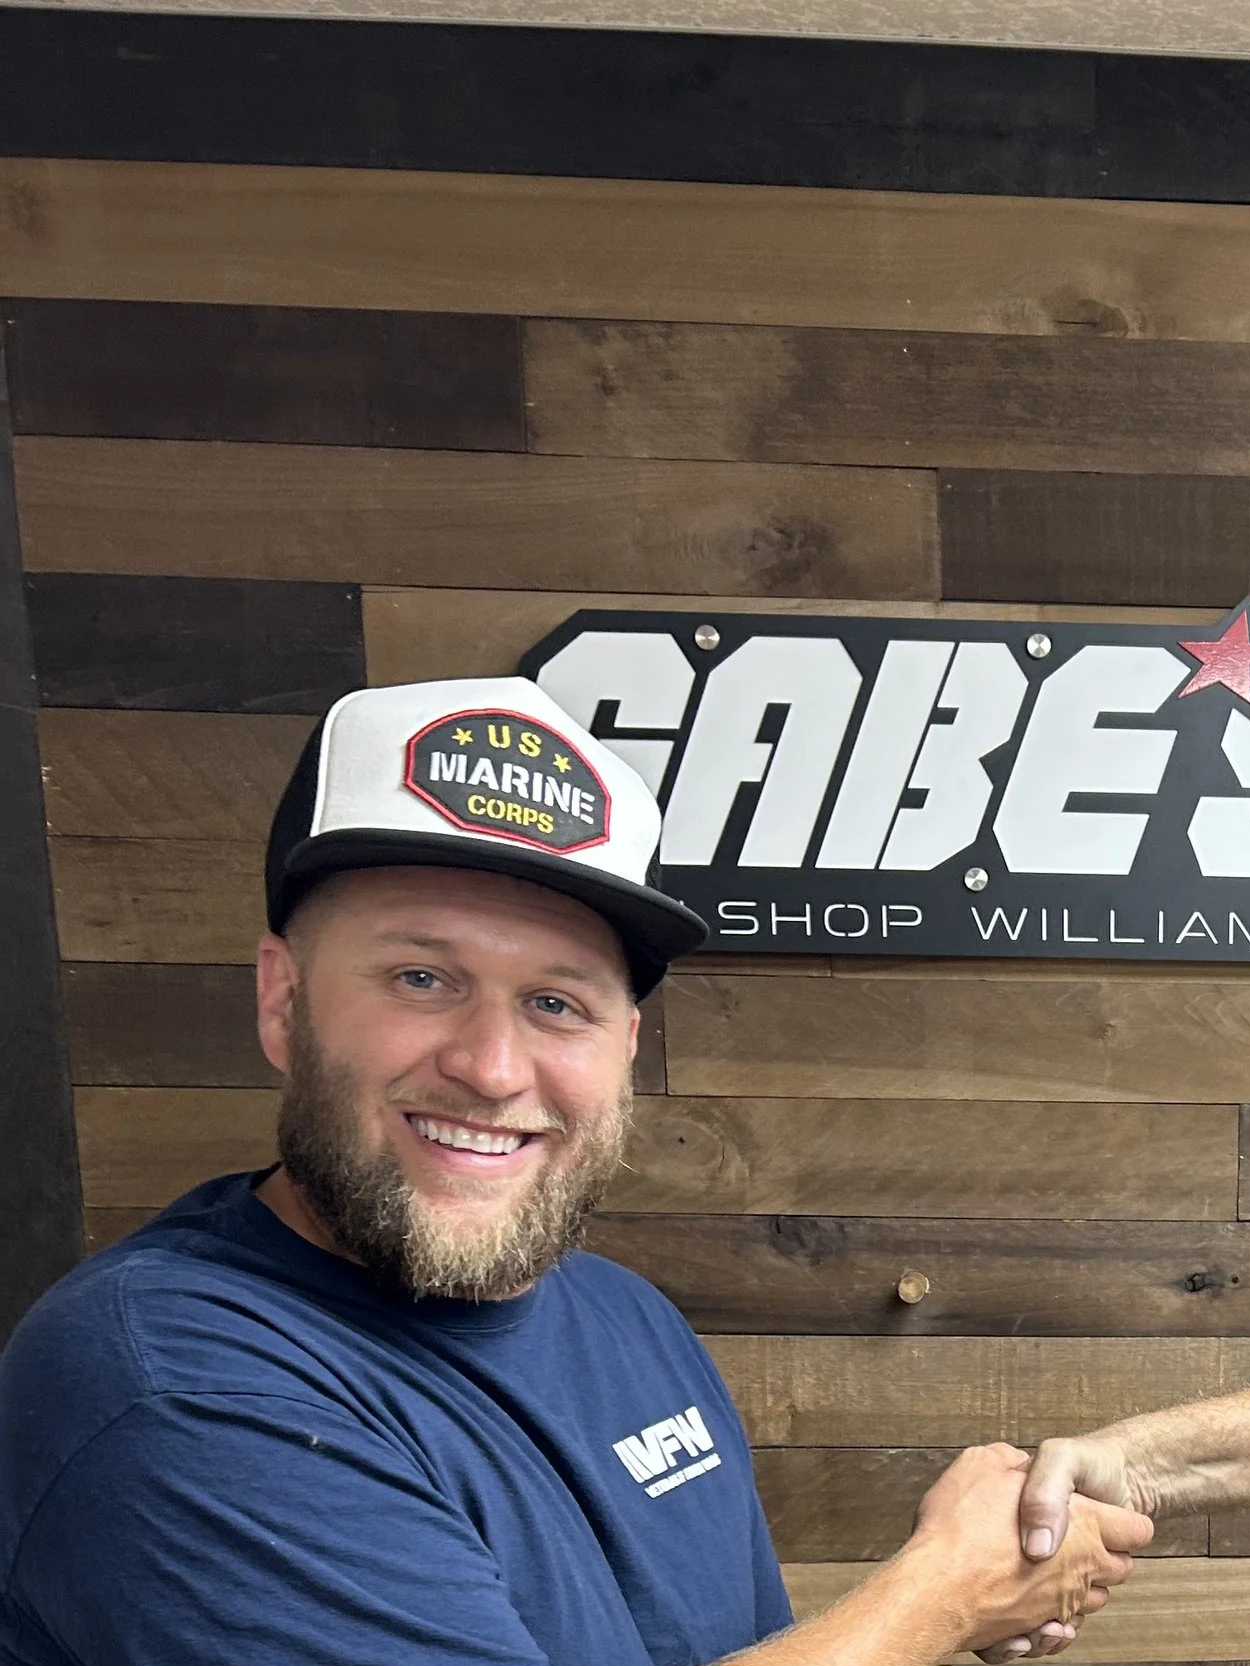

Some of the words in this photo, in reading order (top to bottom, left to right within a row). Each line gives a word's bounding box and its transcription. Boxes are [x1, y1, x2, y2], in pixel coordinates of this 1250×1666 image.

[486, 724, 543, 758] US
[429, 751, 596, 825] MARINE
[467, 794, 555, 834] CORPS
[718, 901, 925, 939] SHOP
[612, 1406, 714, 1484] VFW
